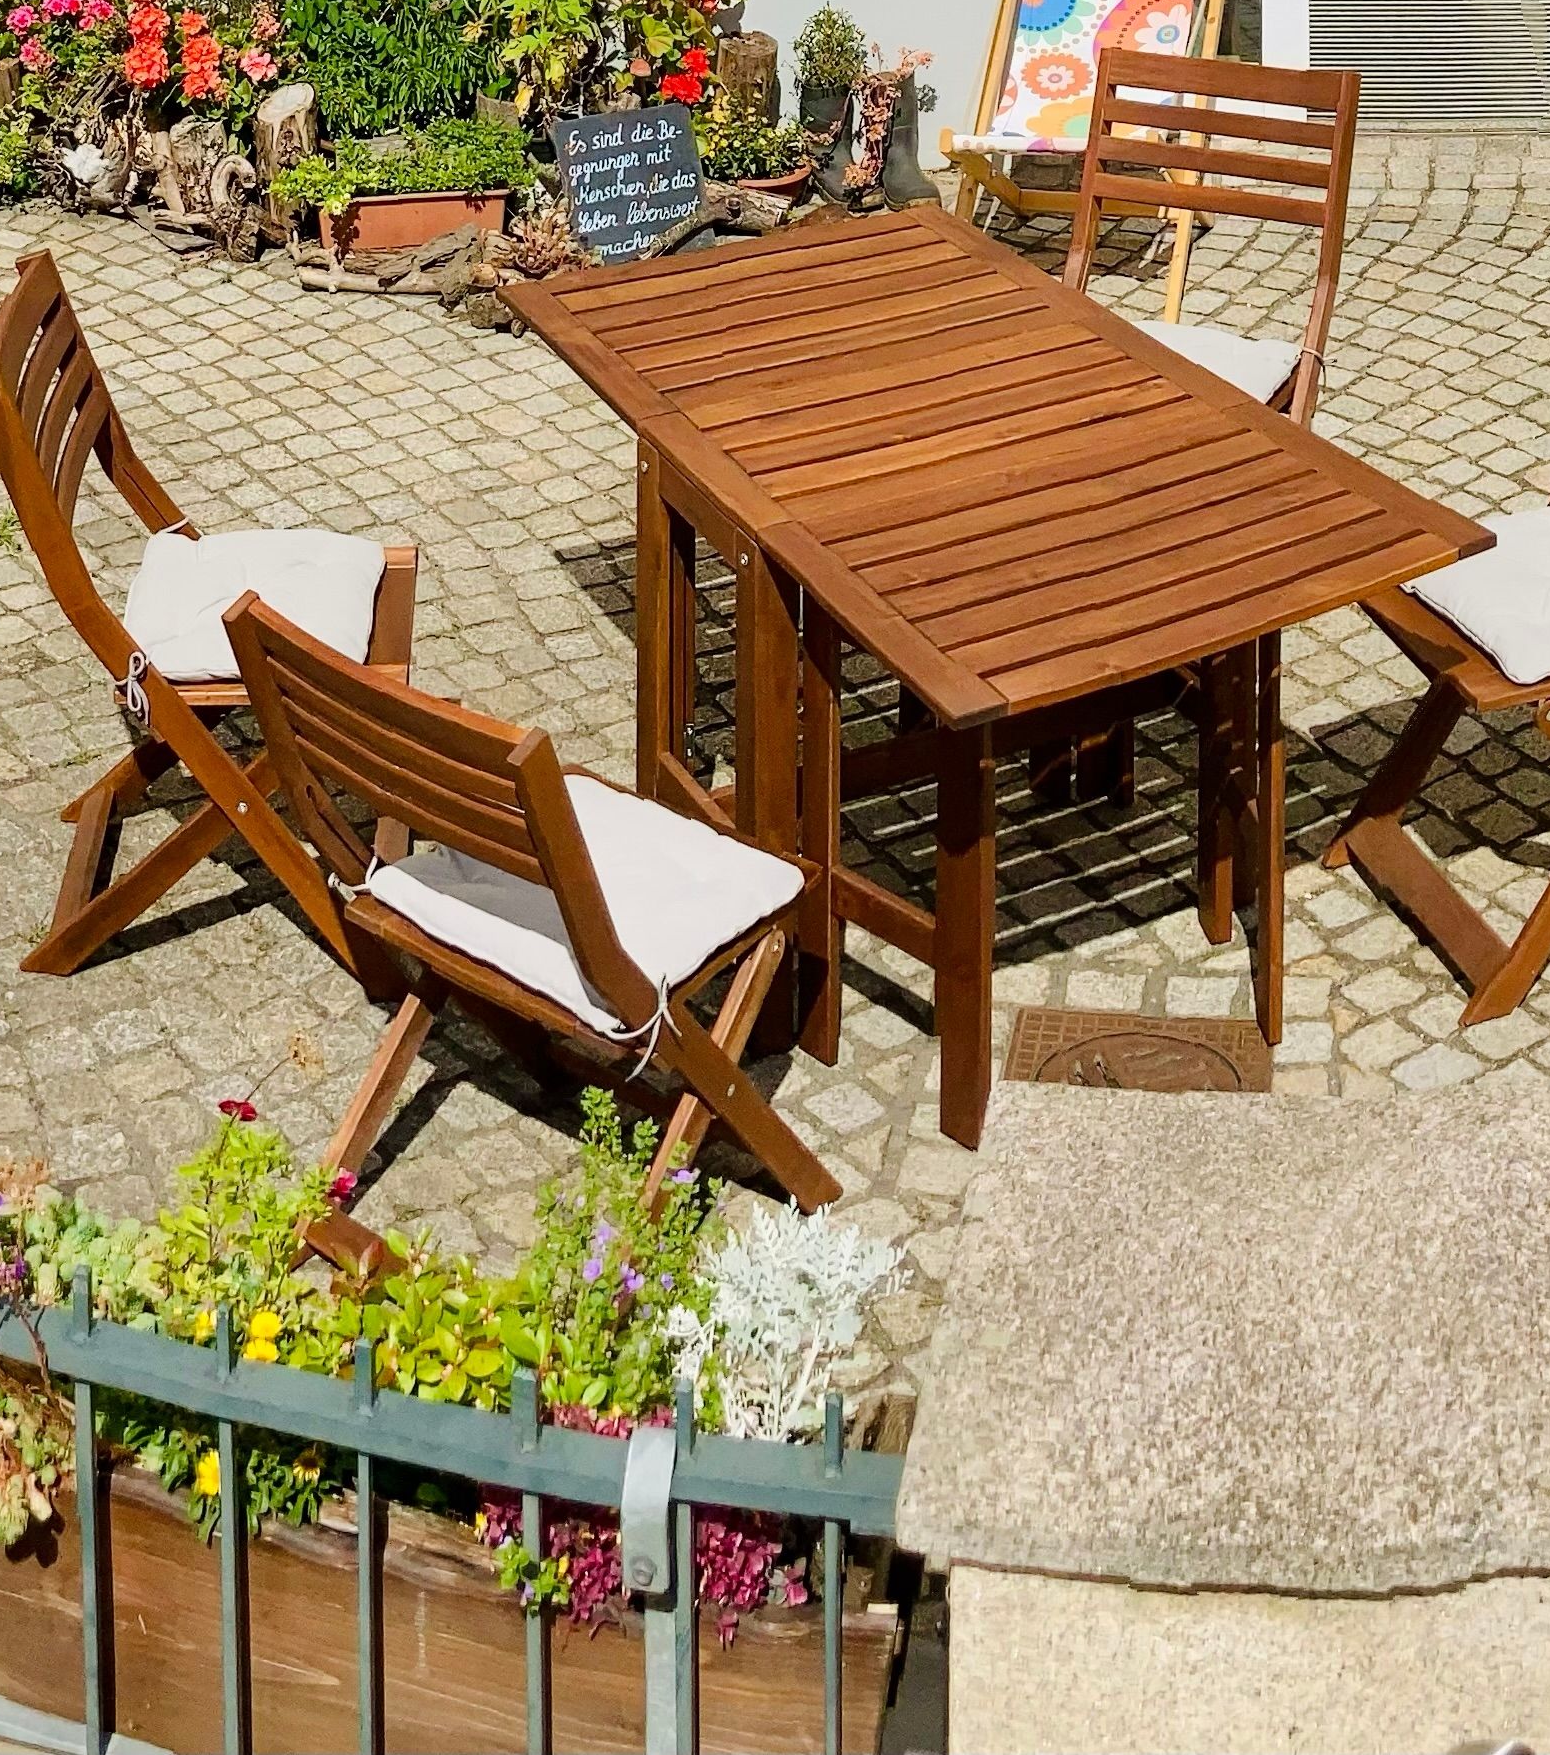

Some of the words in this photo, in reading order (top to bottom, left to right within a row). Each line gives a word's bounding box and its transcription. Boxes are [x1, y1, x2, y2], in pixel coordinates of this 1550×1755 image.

[569, 129, 587, 156] Es
[592, 123, 624, 150] sind
[631, 122, 654, 144] die
[657, 119, 683, 141] Be-
[568, 151, 641, 186] gegnungen
[646, 144, 673, 166] mit
[671, 169, 697, 189] das
[577, 208, 618, 234] Leben
[625, 195, 701, 226] lebenswert
